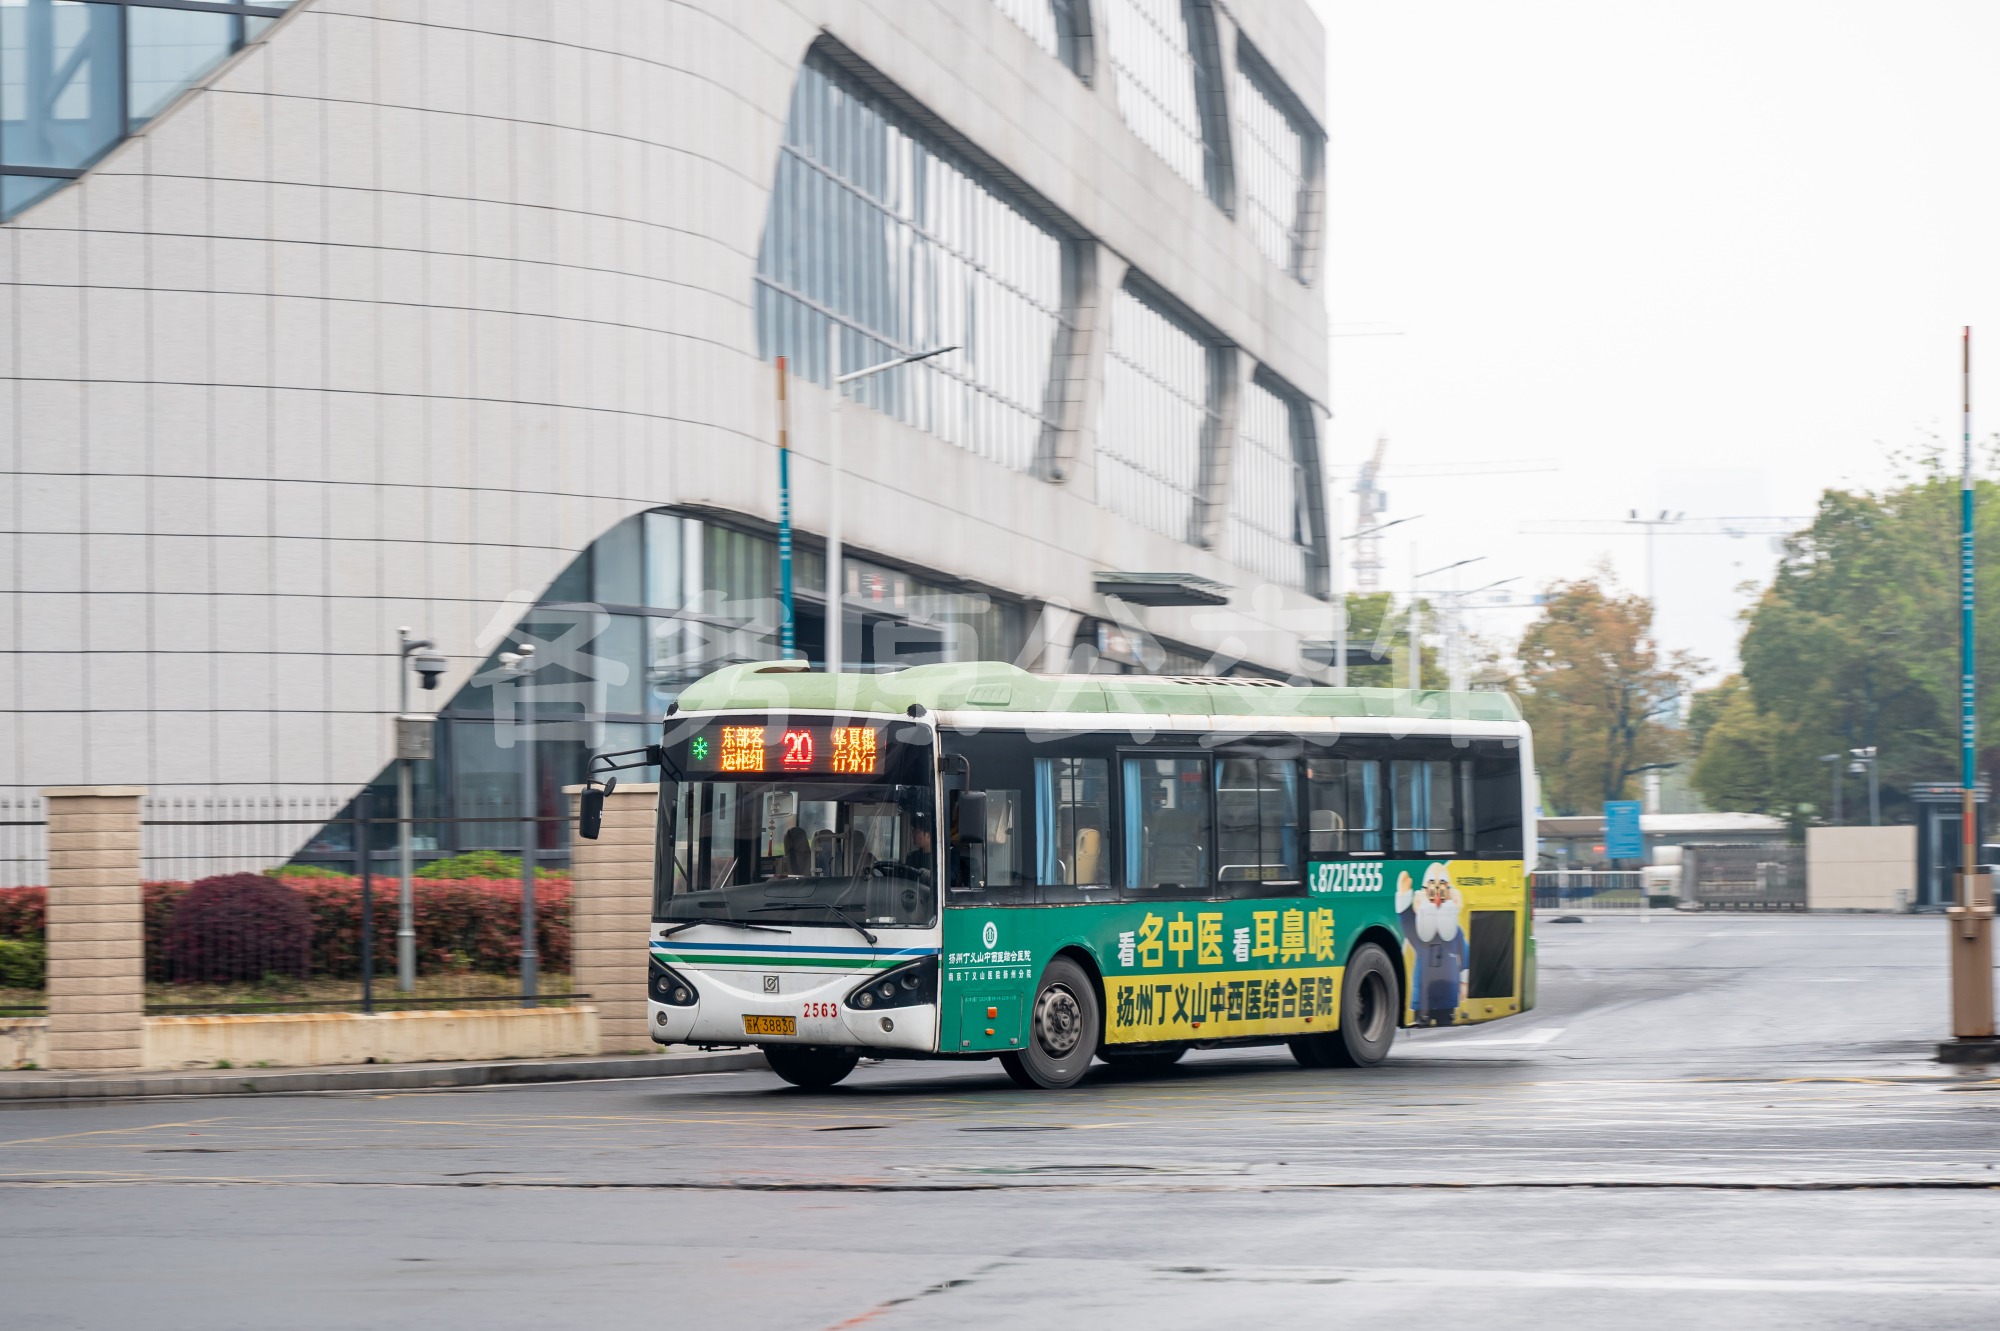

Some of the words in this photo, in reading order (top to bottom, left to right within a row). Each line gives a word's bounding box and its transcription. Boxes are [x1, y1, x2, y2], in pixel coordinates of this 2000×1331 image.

[722, 727, 764, 749] 东部客
[784, 732, 813, 763] 20
[833, 728, 876, 750] 华夏银
[721, 749, 765, 771] 运枢纽
[833, 750, 877, 773] 行分行
[1318, 862, 1384, 893] 87215555
[803, 1002, 838, 1018] 2563
[1116, 976, 1333, 1028] 扬州丁义山中西医结合医院
